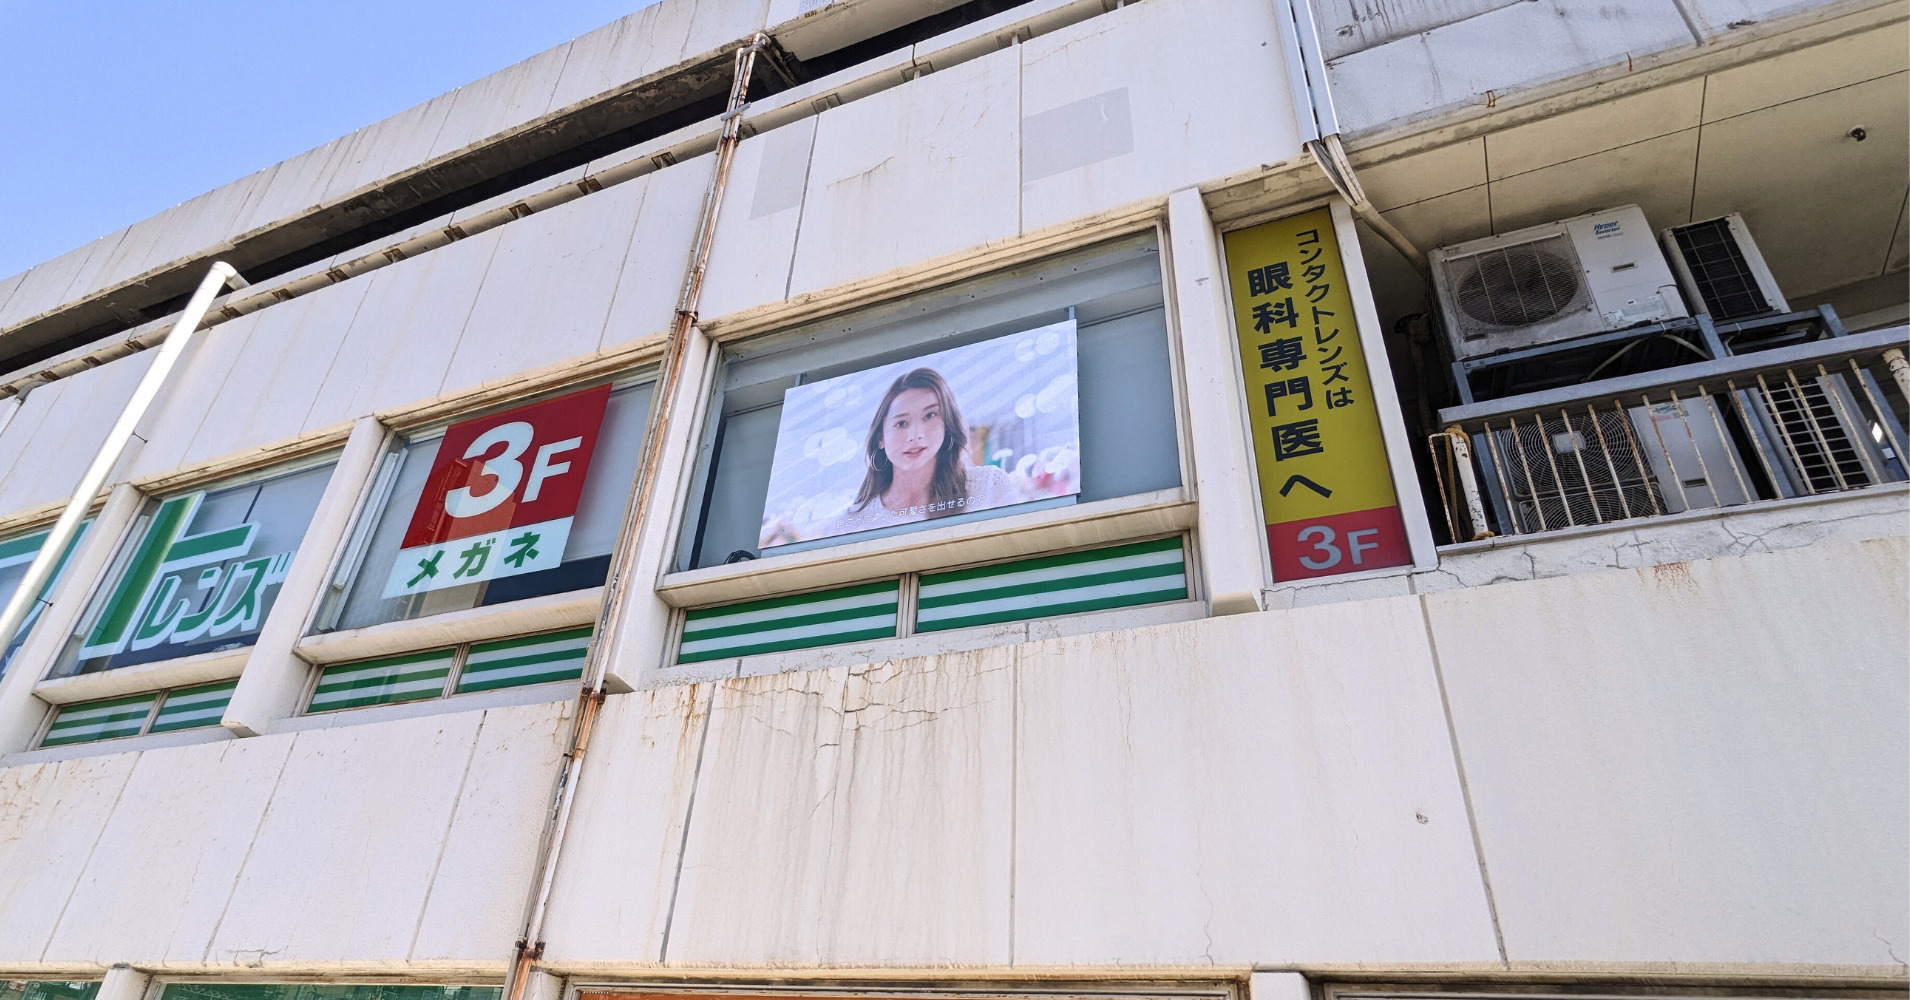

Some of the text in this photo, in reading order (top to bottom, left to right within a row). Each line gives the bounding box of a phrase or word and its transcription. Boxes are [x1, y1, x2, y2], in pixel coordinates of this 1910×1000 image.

[1296, 229, 1354, 410] コンタクトレンズは
[1248, 261, 1333, 499] 眼科専門医へ
[444, 421, 583, 518] 3F
[407, 531, 541, 588] メガネ
[1297, 525, 1379, 570] 3F
[132, 551, 296, 650] レンズ
